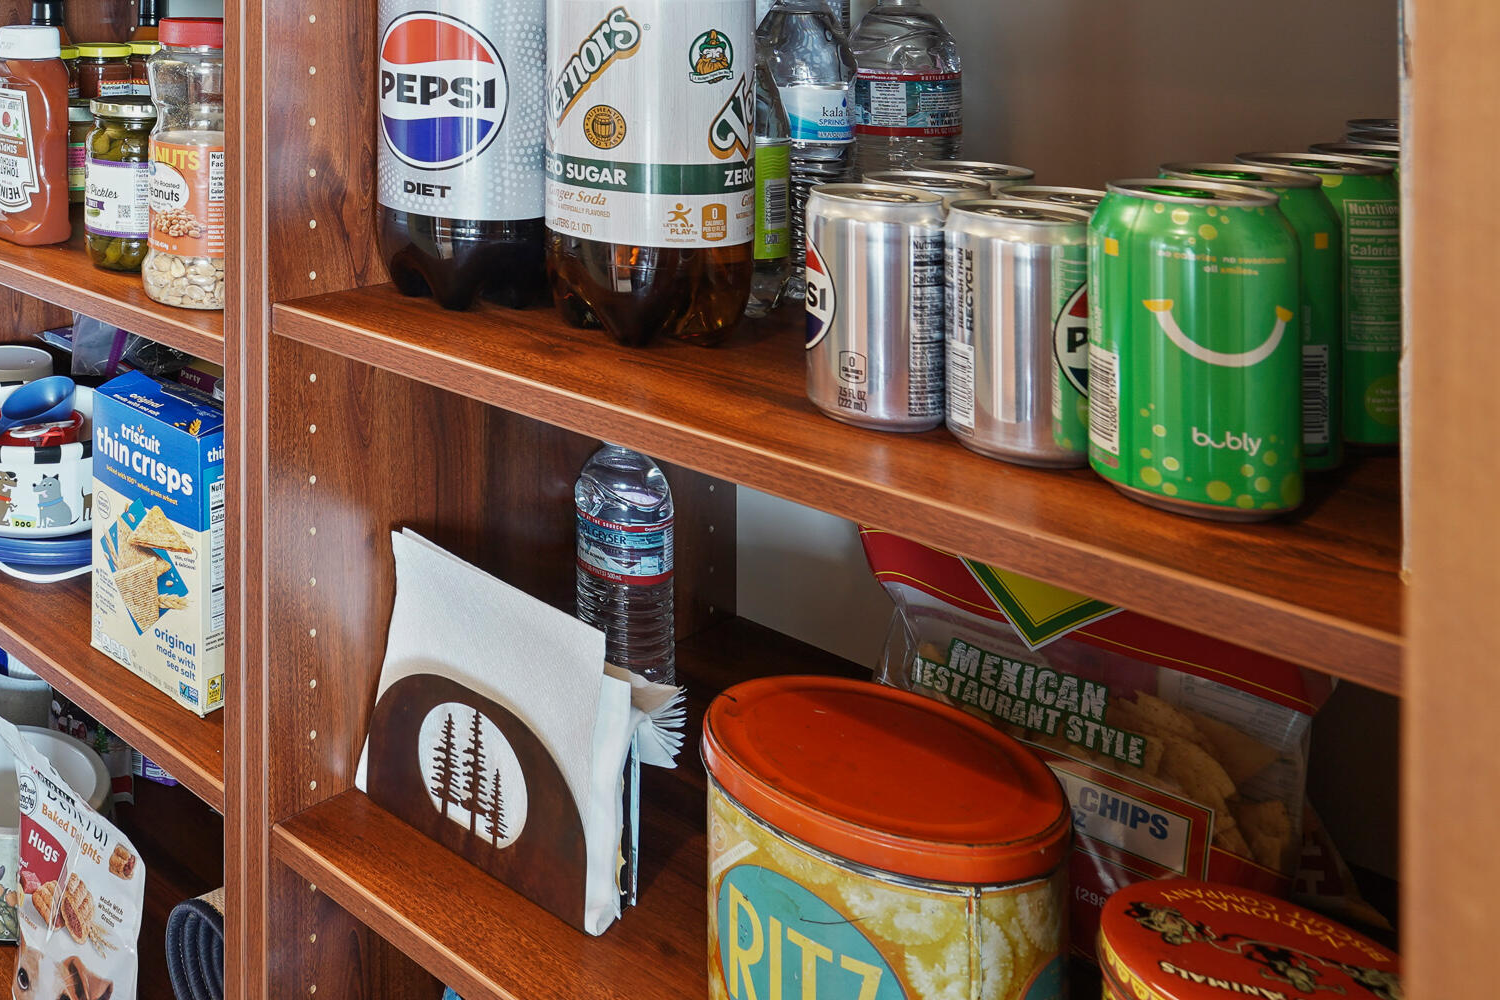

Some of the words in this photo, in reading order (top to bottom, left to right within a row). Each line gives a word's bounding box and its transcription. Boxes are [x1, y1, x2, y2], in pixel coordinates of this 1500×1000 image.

[550, 7, 641, 126] ernors
[381, 69, 496, 110] PEPSI
[586, 106, 624, 126] AUTHENTIC
[821, 106, 844, 118] kala
[818, 118, 845, 127] SPRING
[585, 128, 603, 147] BOLD
[604, 129, 624, 148] TASTE
[546, 155, 564, 176] ERO
[565, 163, 628, 187] SUGAR
[90, 184, 120, 200] Pickles
[150, 186, 180, 203] eanuts
[160, 180, 180, 190] Roasted
[403, 180, 451, 198] DIET
[575, 190, 608, 206] Soda
[585, 208, 611, 219] FLAVORED
[711, 207, 718, 220] 0
[670, 228, 692, 236] PLAY
[1173, 250, 1217, 263] calories
[1222, 256, 1237, 264] no
[1203, 265, 1218, 274] all
[964, 249, 974, 332] RECYCLE
[848, 356, 856, 367] 0
[180, 368, 201, 385] Party
[129, 392, 165, 409] original
[849, 387, 856, 398] FL
[857, 389, 867, 399] OZ
[837, 396, 852, 409] (222
[853, 398, 868, 413] mL)
[121, 423, 161, 455] triscuit
[1191, 426, 1262, 457] bubly
[96, 426, 130, 468] thin
[131, 450, 193, 496] crisps
[15, 520, 32, 528] DOG
[592, 516, 601, 525] THE
[602, 520, 623, 531] SOURCE
[590, 526, 627, 546] GEYSER
[154, 627, 196, 657] original
[156, 644, 177, 660] made
[177, 654, 196, 671] with
[166, 660, 179, 673] sea
[179, 667, 196, 682] salt
[950, 641, 1108, 723] MEXICAN
[911, 658, 1062, 736] RESTAURANT
[1063, 713, 1147, 768] STYLE
[1078, 785, 1170, 841] CHIPS
[41, 803, 69, 833] Baked
[70, 825, 103, 865] Delights
[27, 829, 61, 863] Hugs
[1160, 887, 1278, 913] COMPANY
[1195, 898, 1347, 950] NATIONAL
[1157, 959, 1288, 1000] ANIMALS
